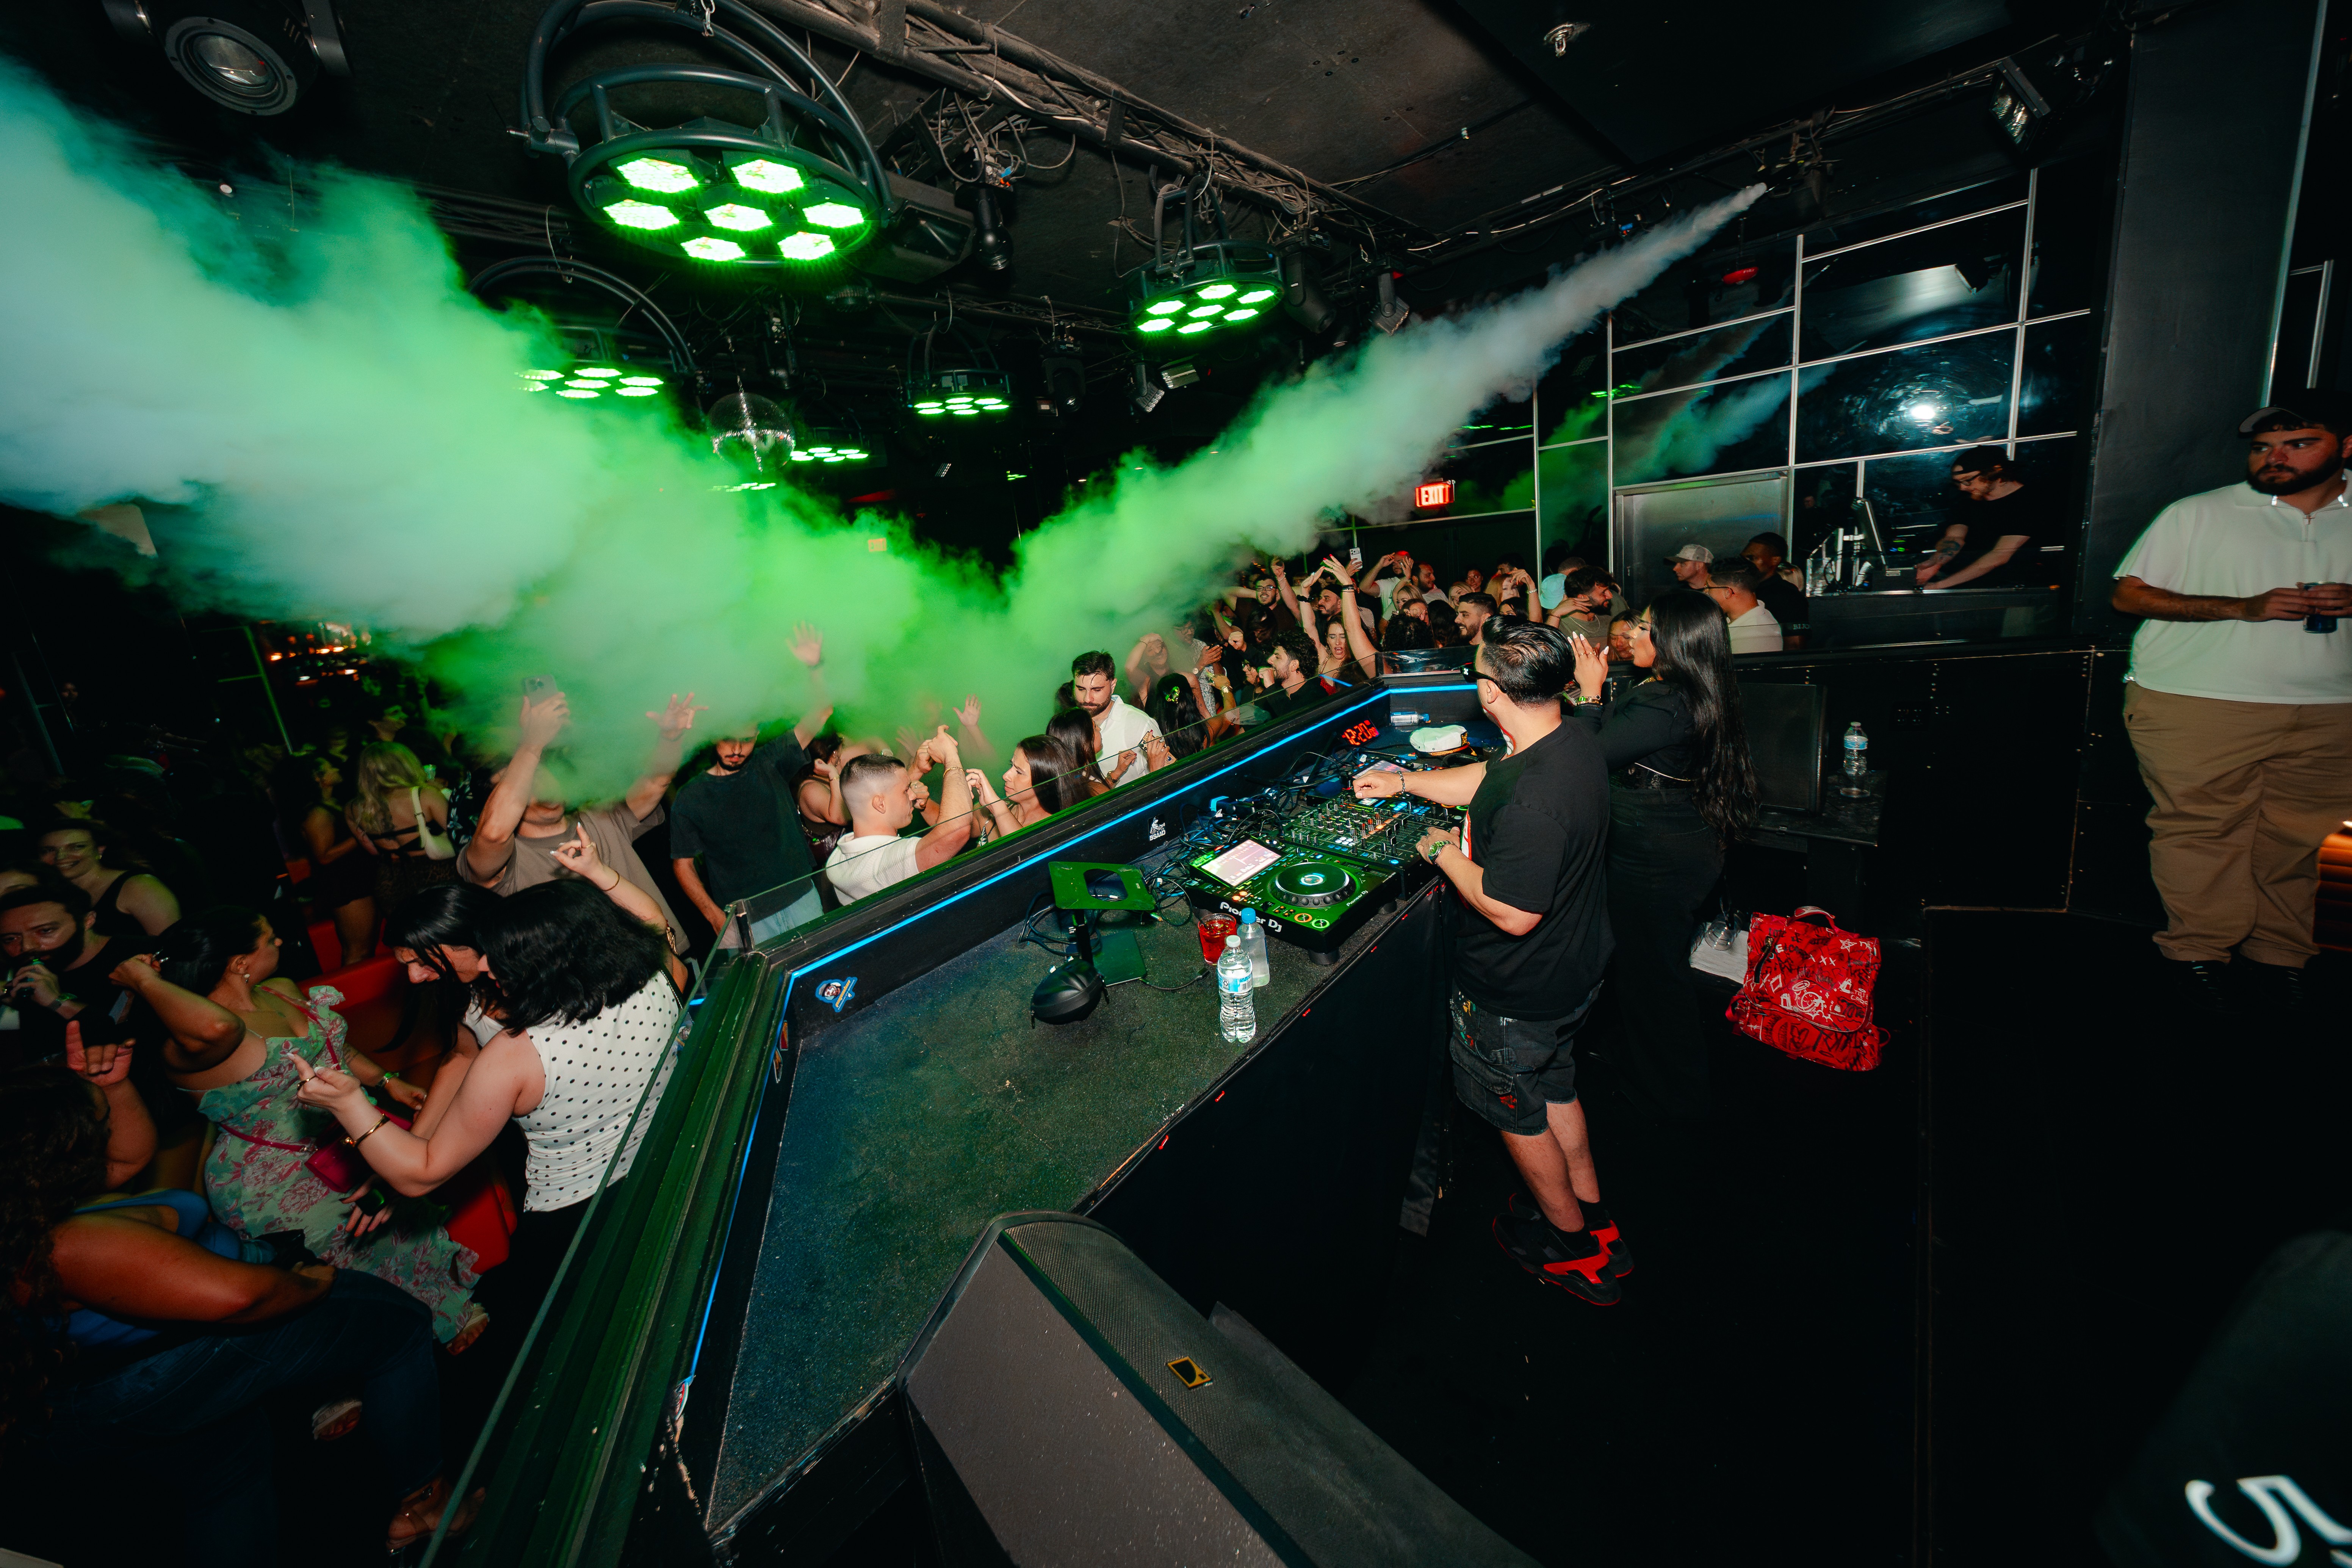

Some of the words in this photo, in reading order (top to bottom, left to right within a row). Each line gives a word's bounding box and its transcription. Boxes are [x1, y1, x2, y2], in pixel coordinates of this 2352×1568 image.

[1421, 485, 1444, 506] EXIT
[1149, 830, 1166, 841] BSAAD
[1346, 894, 1362, 907] Pioneer
